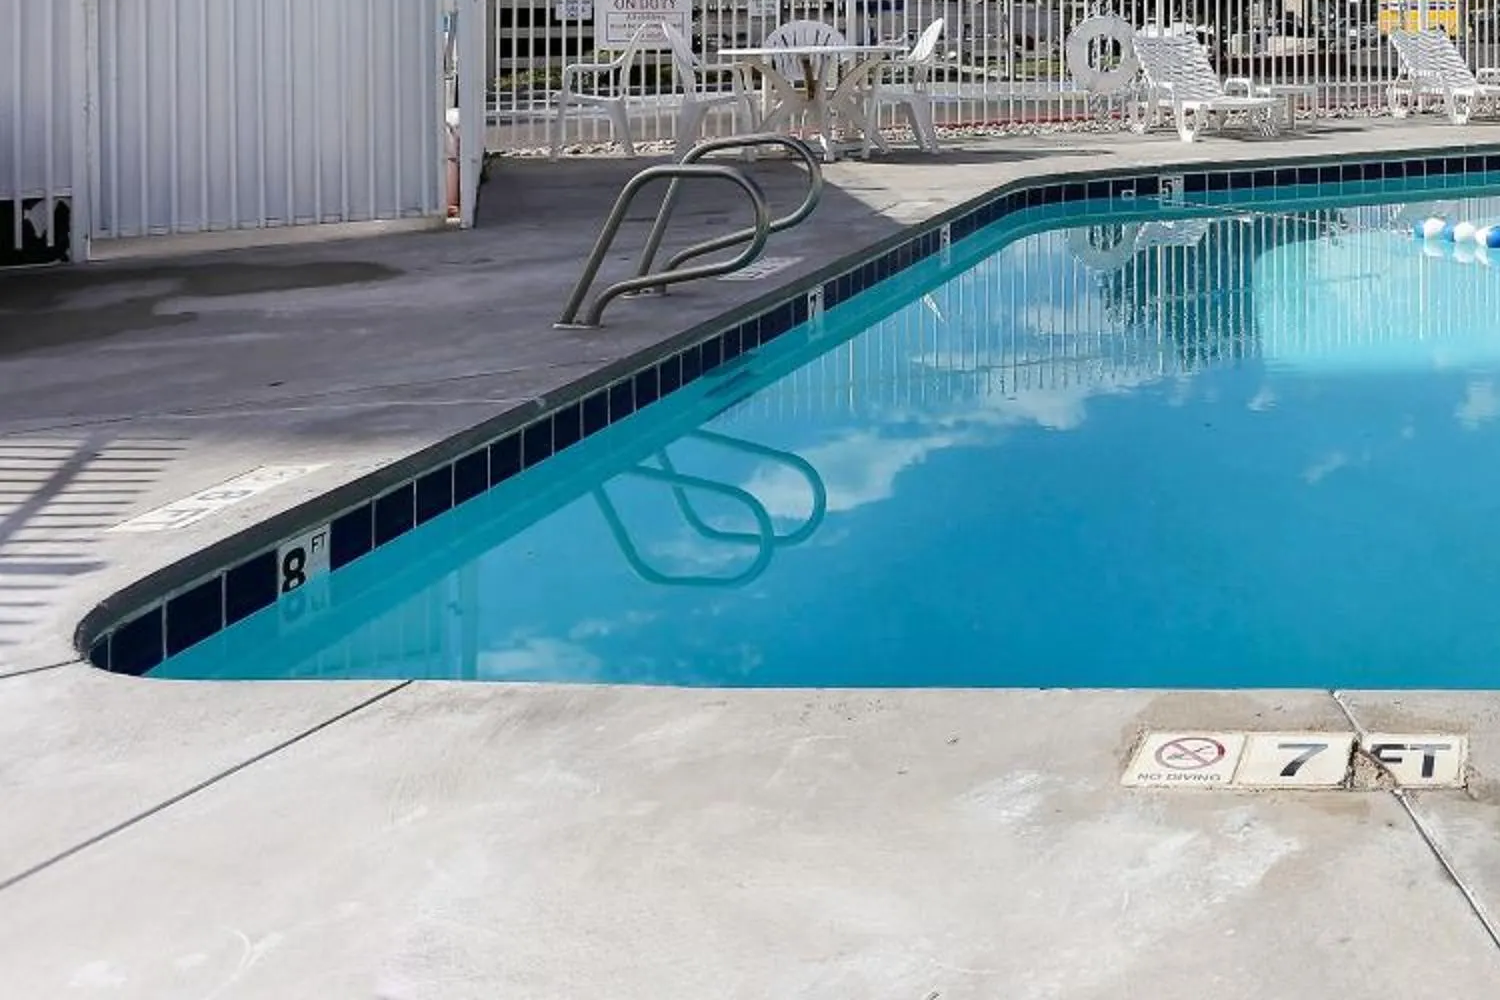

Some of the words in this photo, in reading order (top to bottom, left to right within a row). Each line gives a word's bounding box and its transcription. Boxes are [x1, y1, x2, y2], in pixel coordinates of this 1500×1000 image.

[282, 547, 306, 593] 8
[311, 531, 327, 553] FT
[1137, 773, 1161, 781] NO
[1166, 773, 1222, 781] DIVING
[1278, 743, 1329, 777] 7
[1369, 743, 1452, 778] FT
